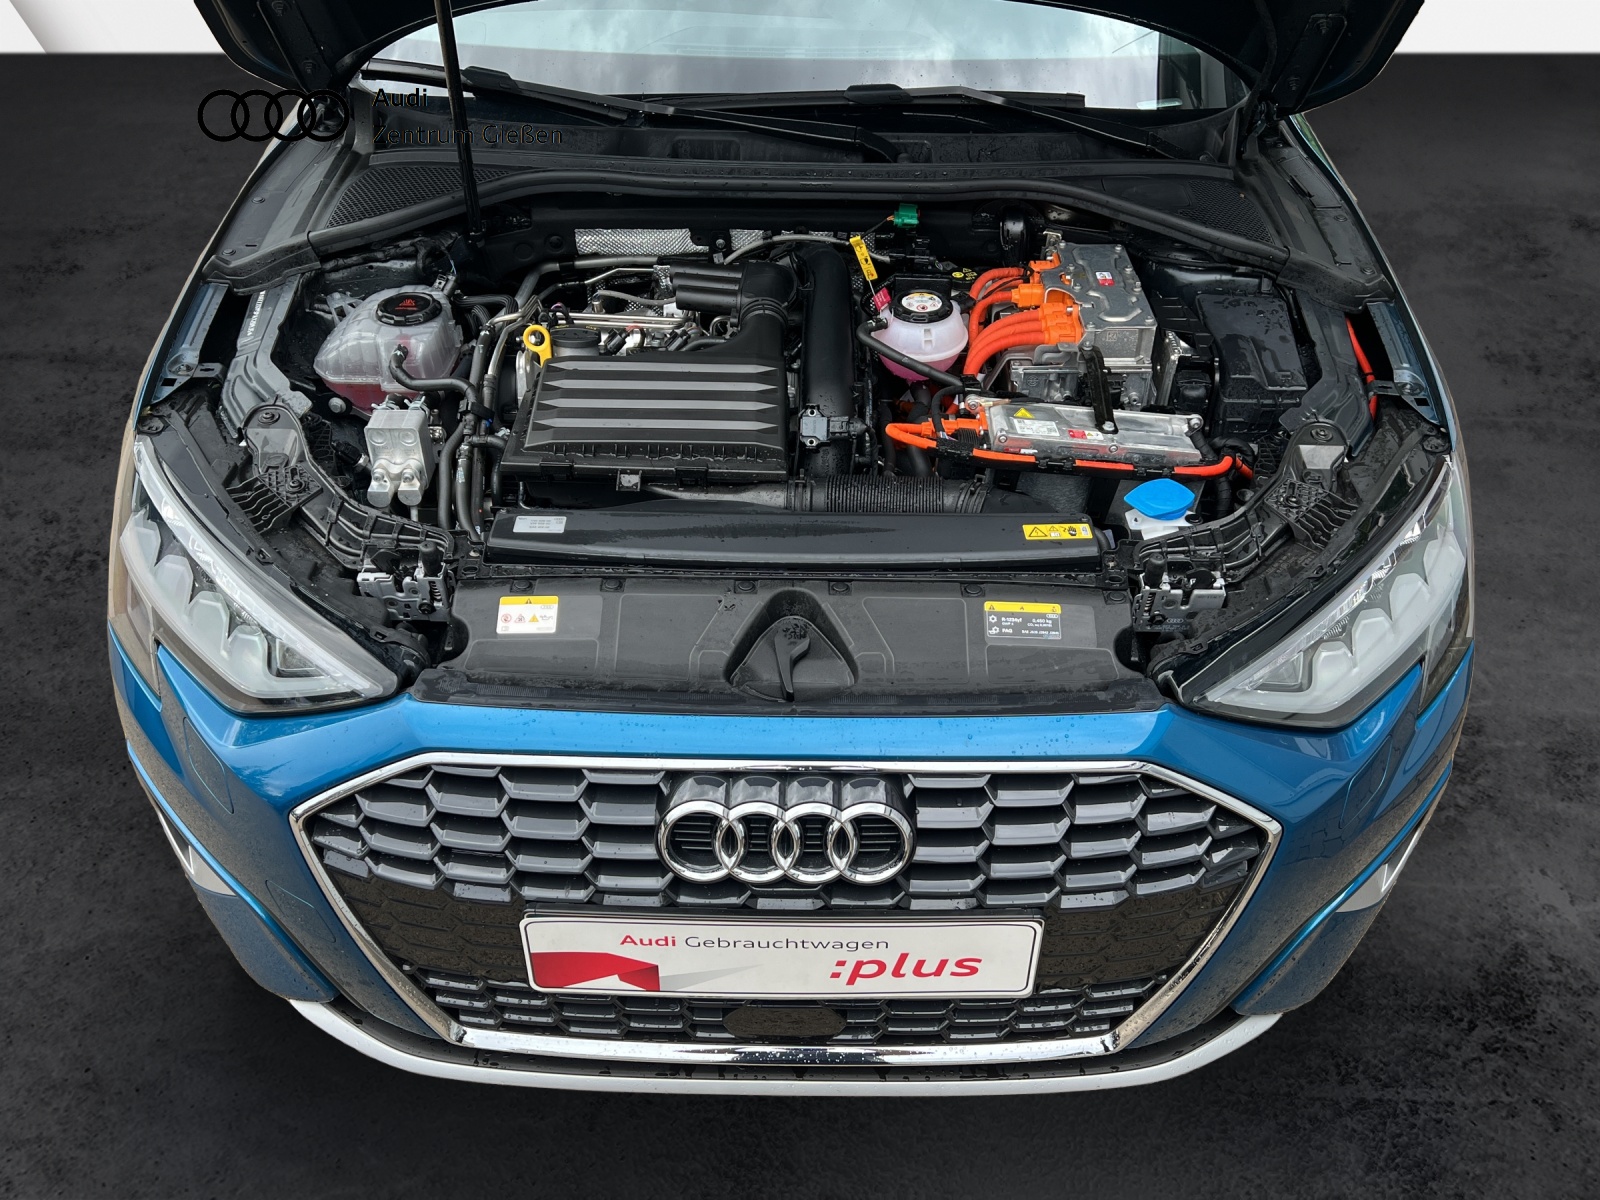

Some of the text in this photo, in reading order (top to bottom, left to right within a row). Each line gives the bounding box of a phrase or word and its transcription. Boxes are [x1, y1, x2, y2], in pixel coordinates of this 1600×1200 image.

[620, 935, 890, 952] Audi Gebrauchtwagen
[830, 952, 982, 986] :plus
